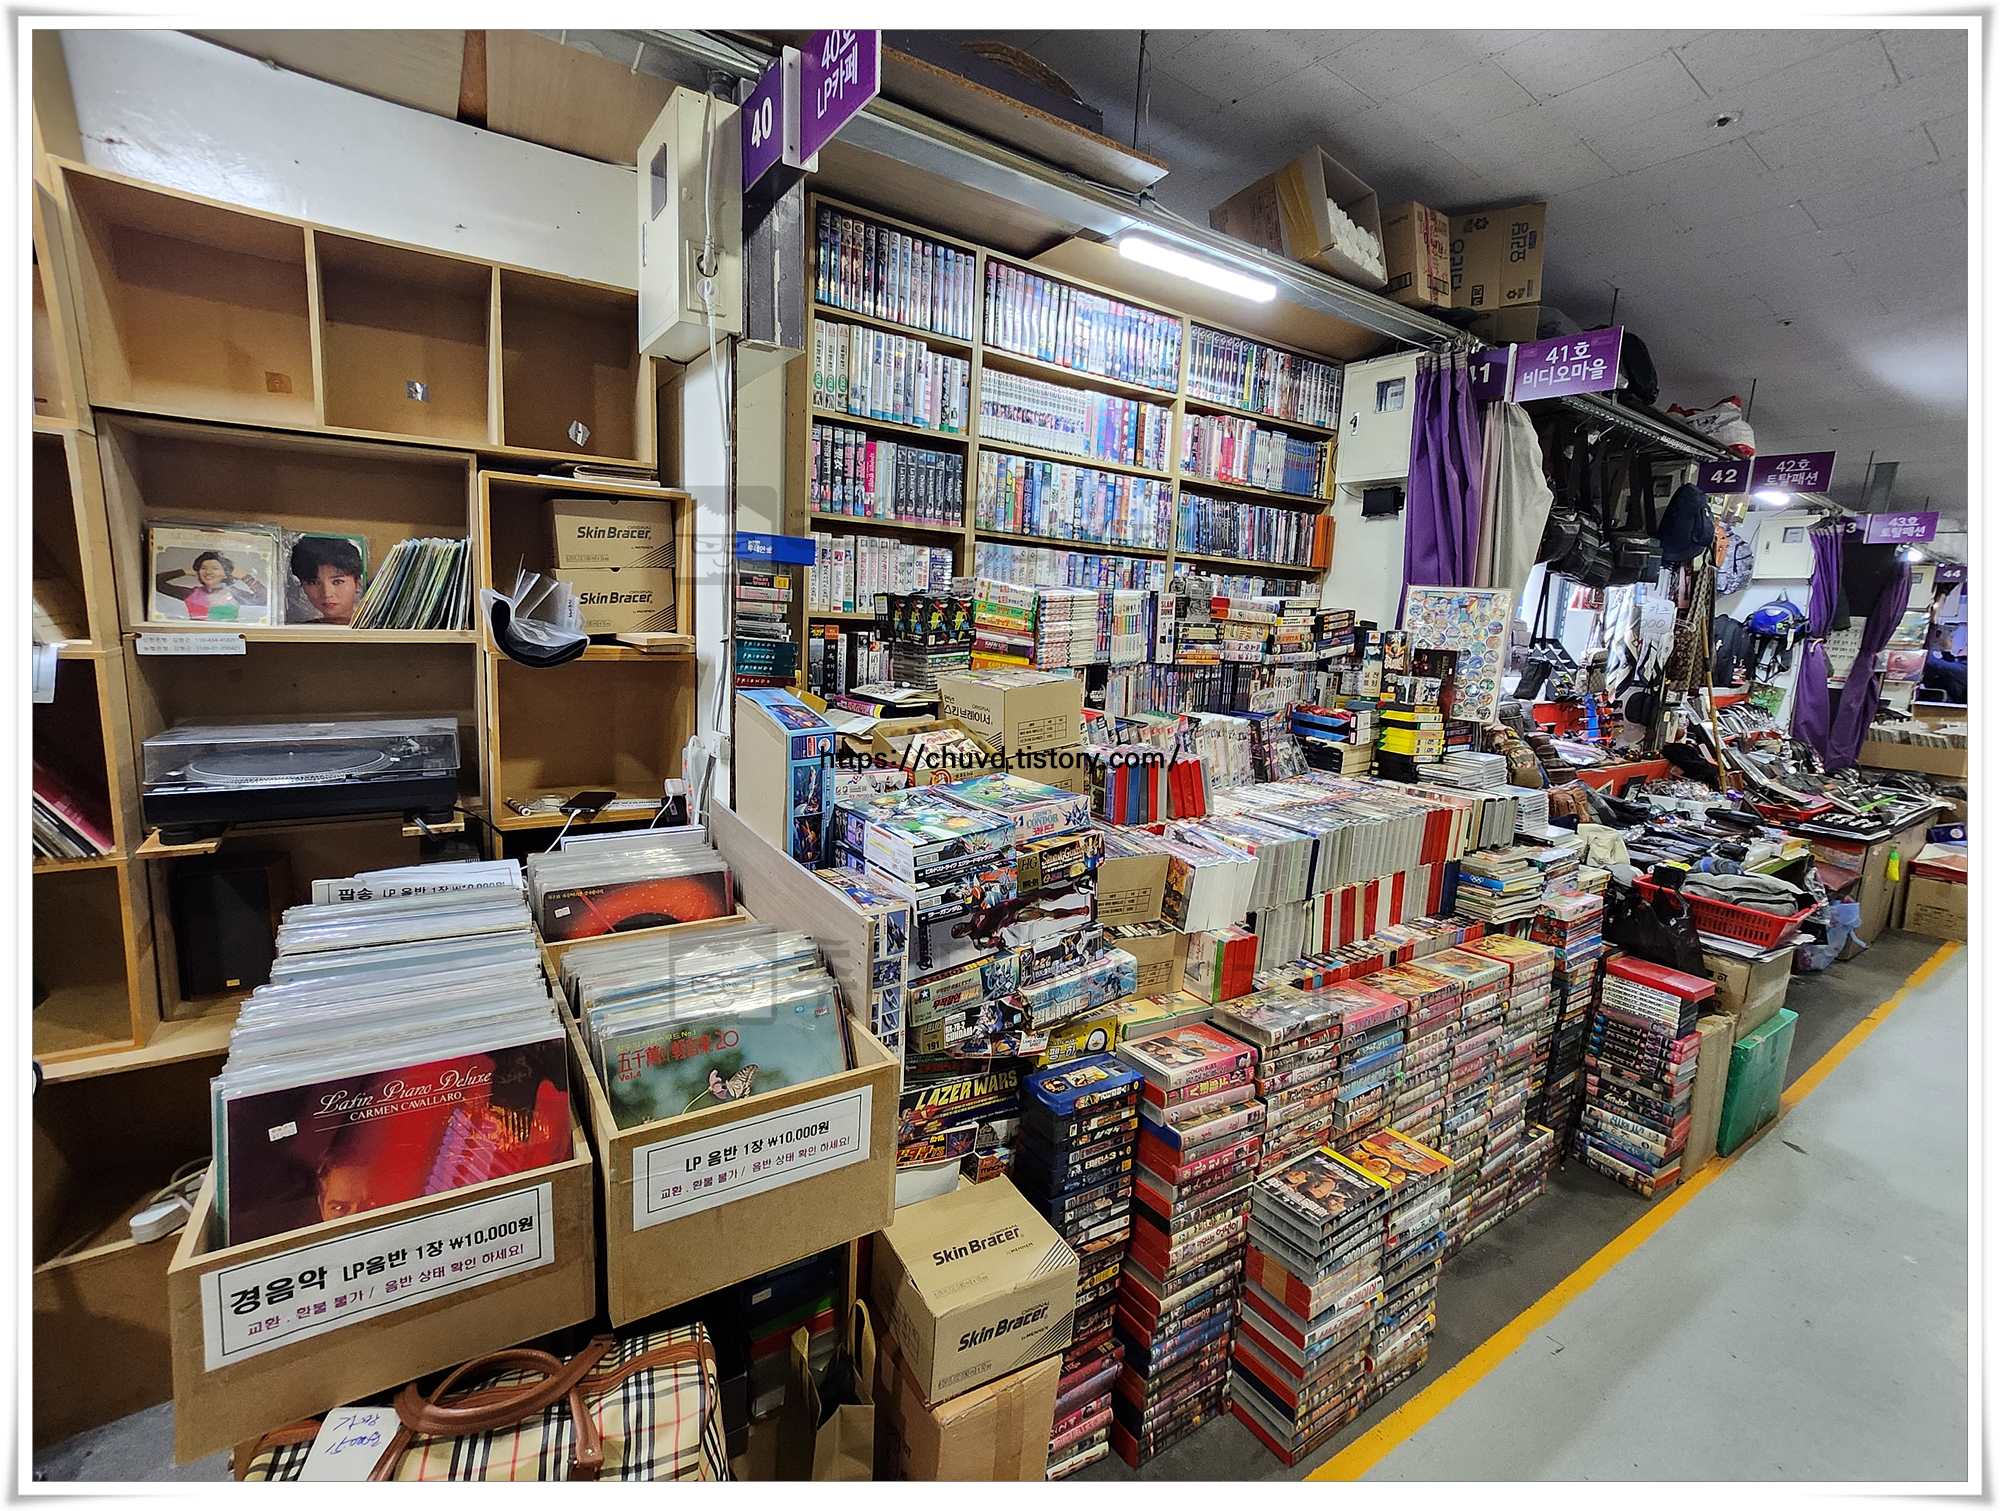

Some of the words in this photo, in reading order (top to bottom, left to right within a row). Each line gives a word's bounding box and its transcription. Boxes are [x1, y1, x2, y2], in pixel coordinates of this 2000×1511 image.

[817, 42, 858, 120] LP카페
[751, 96, 773, 149] 40
[1545, 341, 1592, 364] 41호
[1522, 358, 1608, 388] 비디오마을
[1710, 468, 1738, 484] 42
[1776, 459, 1811, 472] 42호
[577, 526, 606, 539] Skin
[607, 526, 652, 539] Bracer
[1846, 522, 1857, 534] 3
[1888, 516, 1920, 527] 43호
[1943, 569, 1961, 578] 44
[579, 592, 608, 605] Skin
[609, 592, 653, 605] Bracer
[742, 652, 775, 660] FRIENDS
[1022, 856, 1039, 871] HG
[338, 887, 373, 901] 팝송
[383, 887, 396, 898] LP
[927, 1041, 940, 1051] 191
[313, 1089, 374, 1117] Latin
[377, 1080, 433, 1105] Piano
[434, 1066, 493, 1093] Deluxe
[915, 1080, 972, 1111] LAZER
[974, 1070, 1018, 1097] WARS
[350, 1103, 399, 1121] CARMEN
[401, 1091, 462, 1112] CAVALLARO
[685, 1155, 702, 1173] LP
[707, 1145, 738, 1168] 음반
[743, 1139, 763, 1156] 1장
[767, 1120, 830, 1149] ₩10,000원
[660, 1185, 682, 1200] 교환
[692, 1176, 713, 1191] 환불
[717, 1168, 738, 1184] 불가
[752, 1157, 772, 1173] 음반
[776, 1151, 795, 1166] 상태
[798, 1145, 817, 1159] 확인
[820, 1135, 850, 1153] 하세요!
[932, 1244, 969, 1266] Skin
[968, 1227, 1021, 1254] Bracer
[230, 1265, 328, 1316] 경음악
[342, 1248, 408, 1282] LP음반
[415, 1239, 444, 1261] 1장
[448, 1215, 535, 1251] ₩10,000원
[247, 1315, 280, 1337] 교환
[296, 1302, 328, 1321] 환불
[334, 1289, 364, 1310] 불가
[385, 1273, 413, 1295] 음반
[418, 1265, 446, 1284] 상태
[450, 1257, 477, 1274] 확인
[482, 1243, 524, 1265] 하세요!
[957, 1326, 995, 1353] Skin
[994, 1304, 1049, 1338] Bracer
